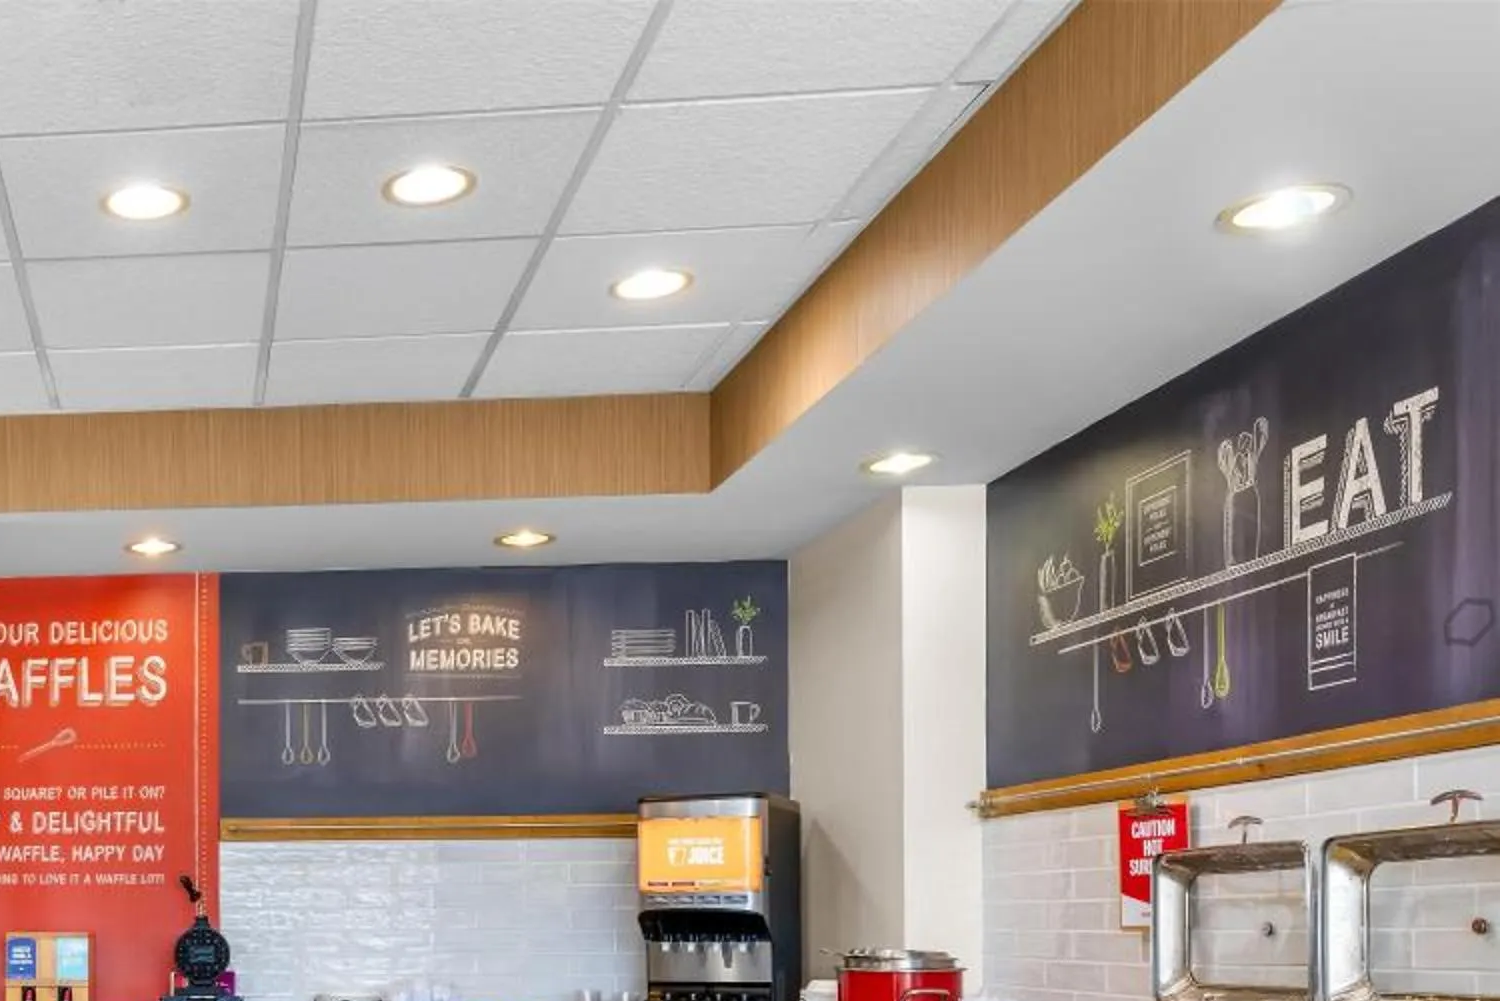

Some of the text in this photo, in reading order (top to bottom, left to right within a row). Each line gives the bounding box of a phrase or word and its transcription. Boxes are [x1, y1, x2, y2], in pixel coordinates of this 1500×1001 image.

[1286, 385, 1439, 546] EAT
[49, 619, 169, 645] DELICIOUS
[408, 613, 521, 643] LET'S BAKE
[1315, 625, 1349, 650] SMILE
[409, 647, 519, 672] MEMORIES
[3, 786, 62, 801] SQUARE?
[67, 786, 87, 800] OR
[91, 785, 118, 800] PILE
[123, 785, 134, 800] IT
[139, 785, 165, 800] ON?
[10, 811, 23, 834] &
[32, 809, 165, 834] DELIGHTFUL
[1131, 818, 1176, 839] CAUTION
[71, 845, 125, 862] HAPPY
[132, 844, 165, 862] DAY
[23, 873, 36, 885] TO
[40, 873, 65, 885] LOVE
[70, 873, 79, 885] IT
[84, 873, 92, 885] A
[95, 872, 137, 885] WAFFLE
